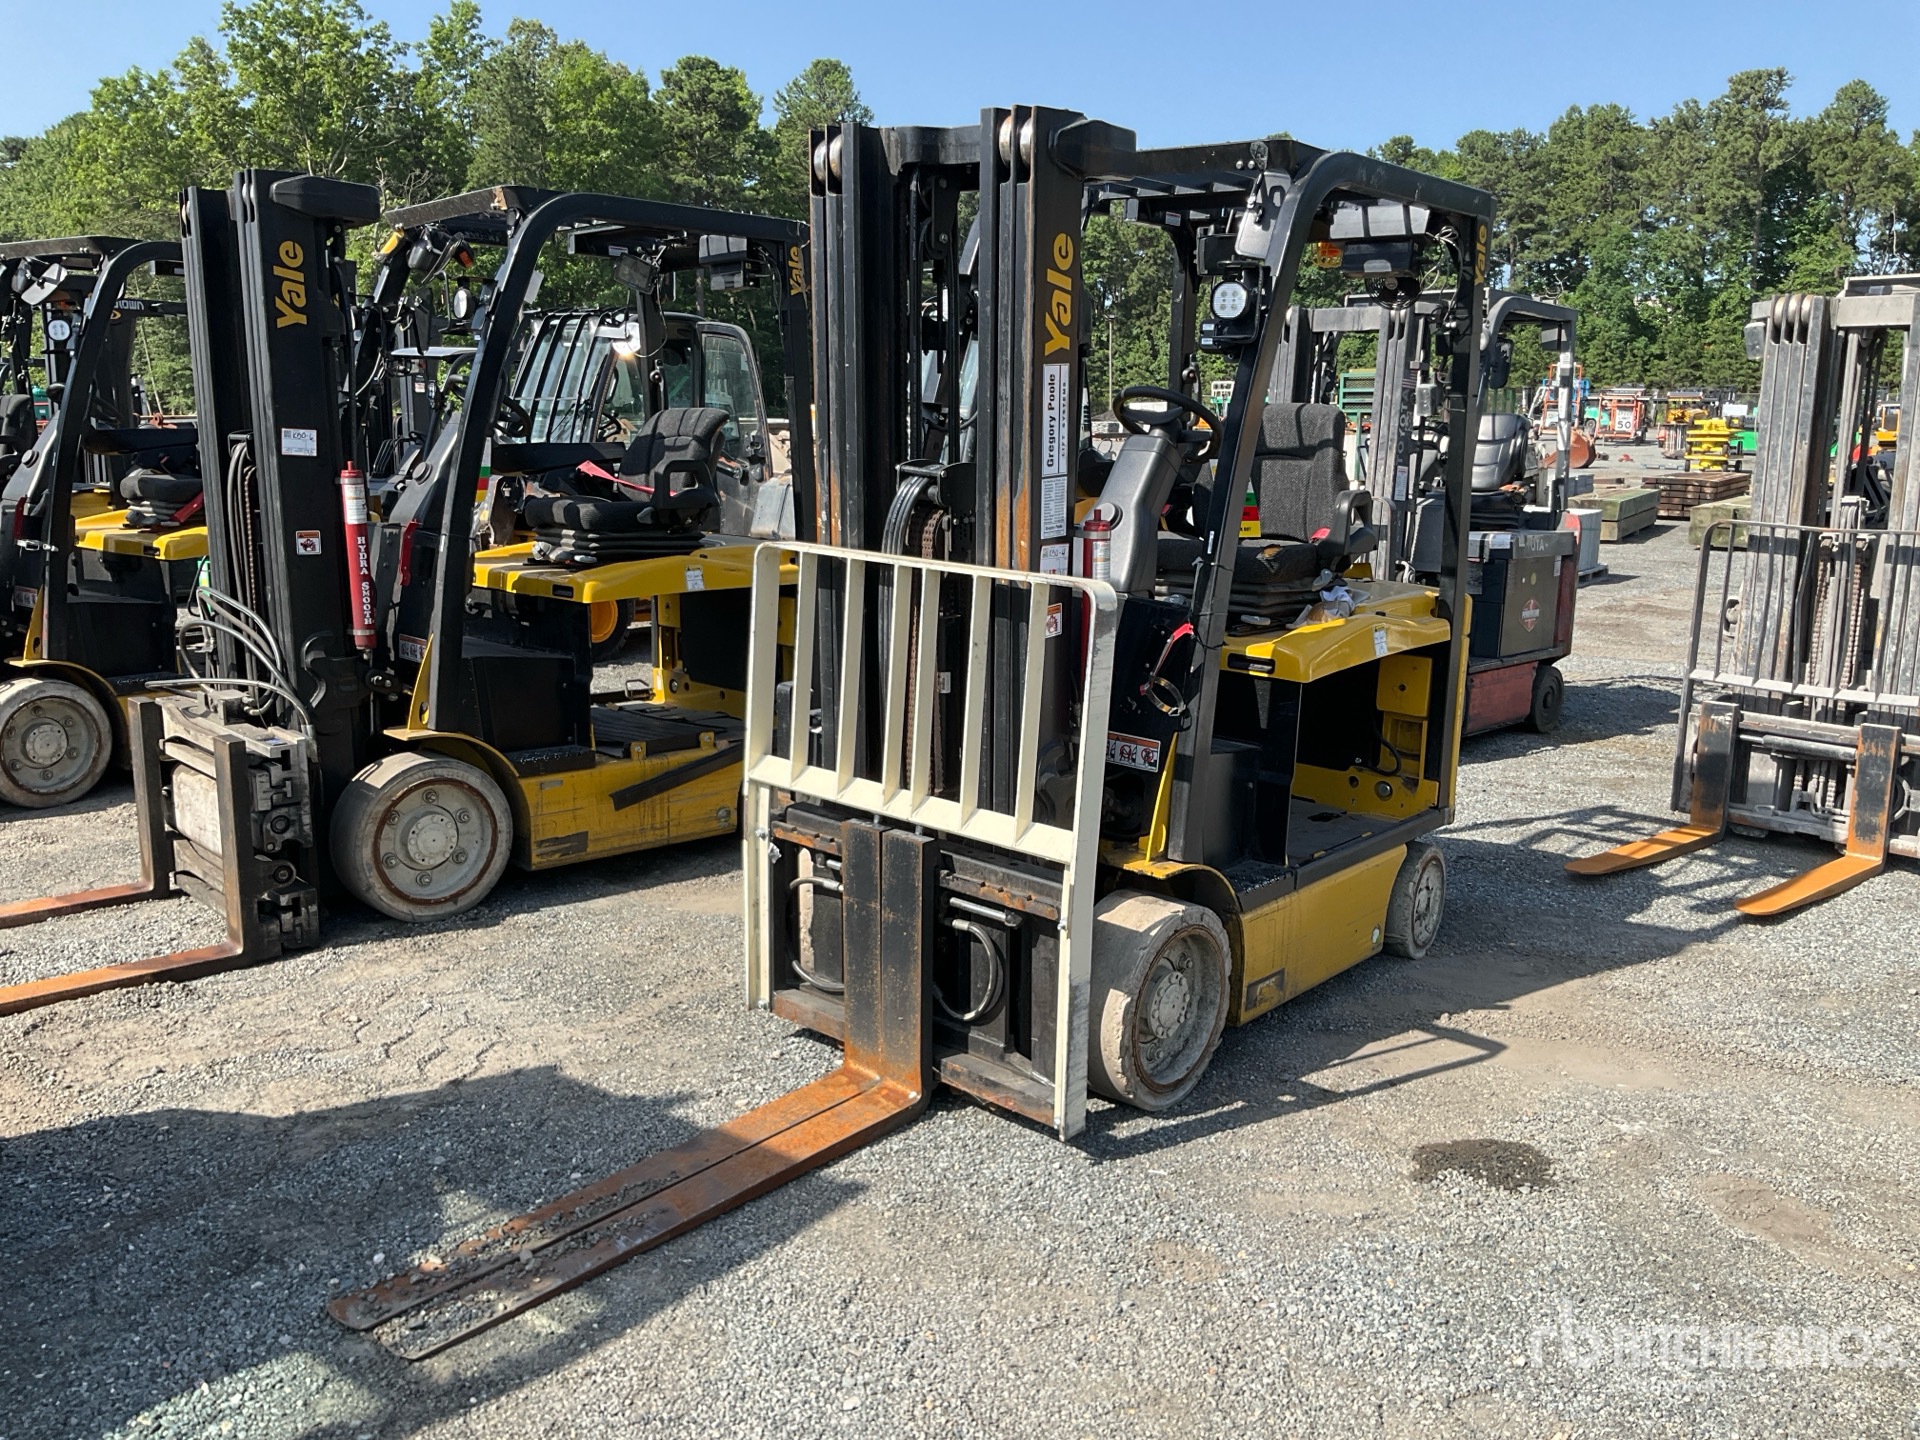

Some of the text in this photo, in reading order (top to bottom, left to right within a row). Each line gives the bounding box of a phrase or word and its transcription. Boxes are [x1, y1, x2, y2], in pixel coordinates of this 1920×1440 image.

[273, 240, 306, 328] Yale
[788, 246, 802, 296] Yale
[1044, 232, 1075, 356] Yale
[1474, 225, 1488, 286] Yale
[1046, 373, 1057, 468] Gregory Poole
[1396, 388, 1409, 466] TOYOTA
[1617, 420, 1632, 429] 50
[357, 536, 373, 625] HYDRA SMOOTH
